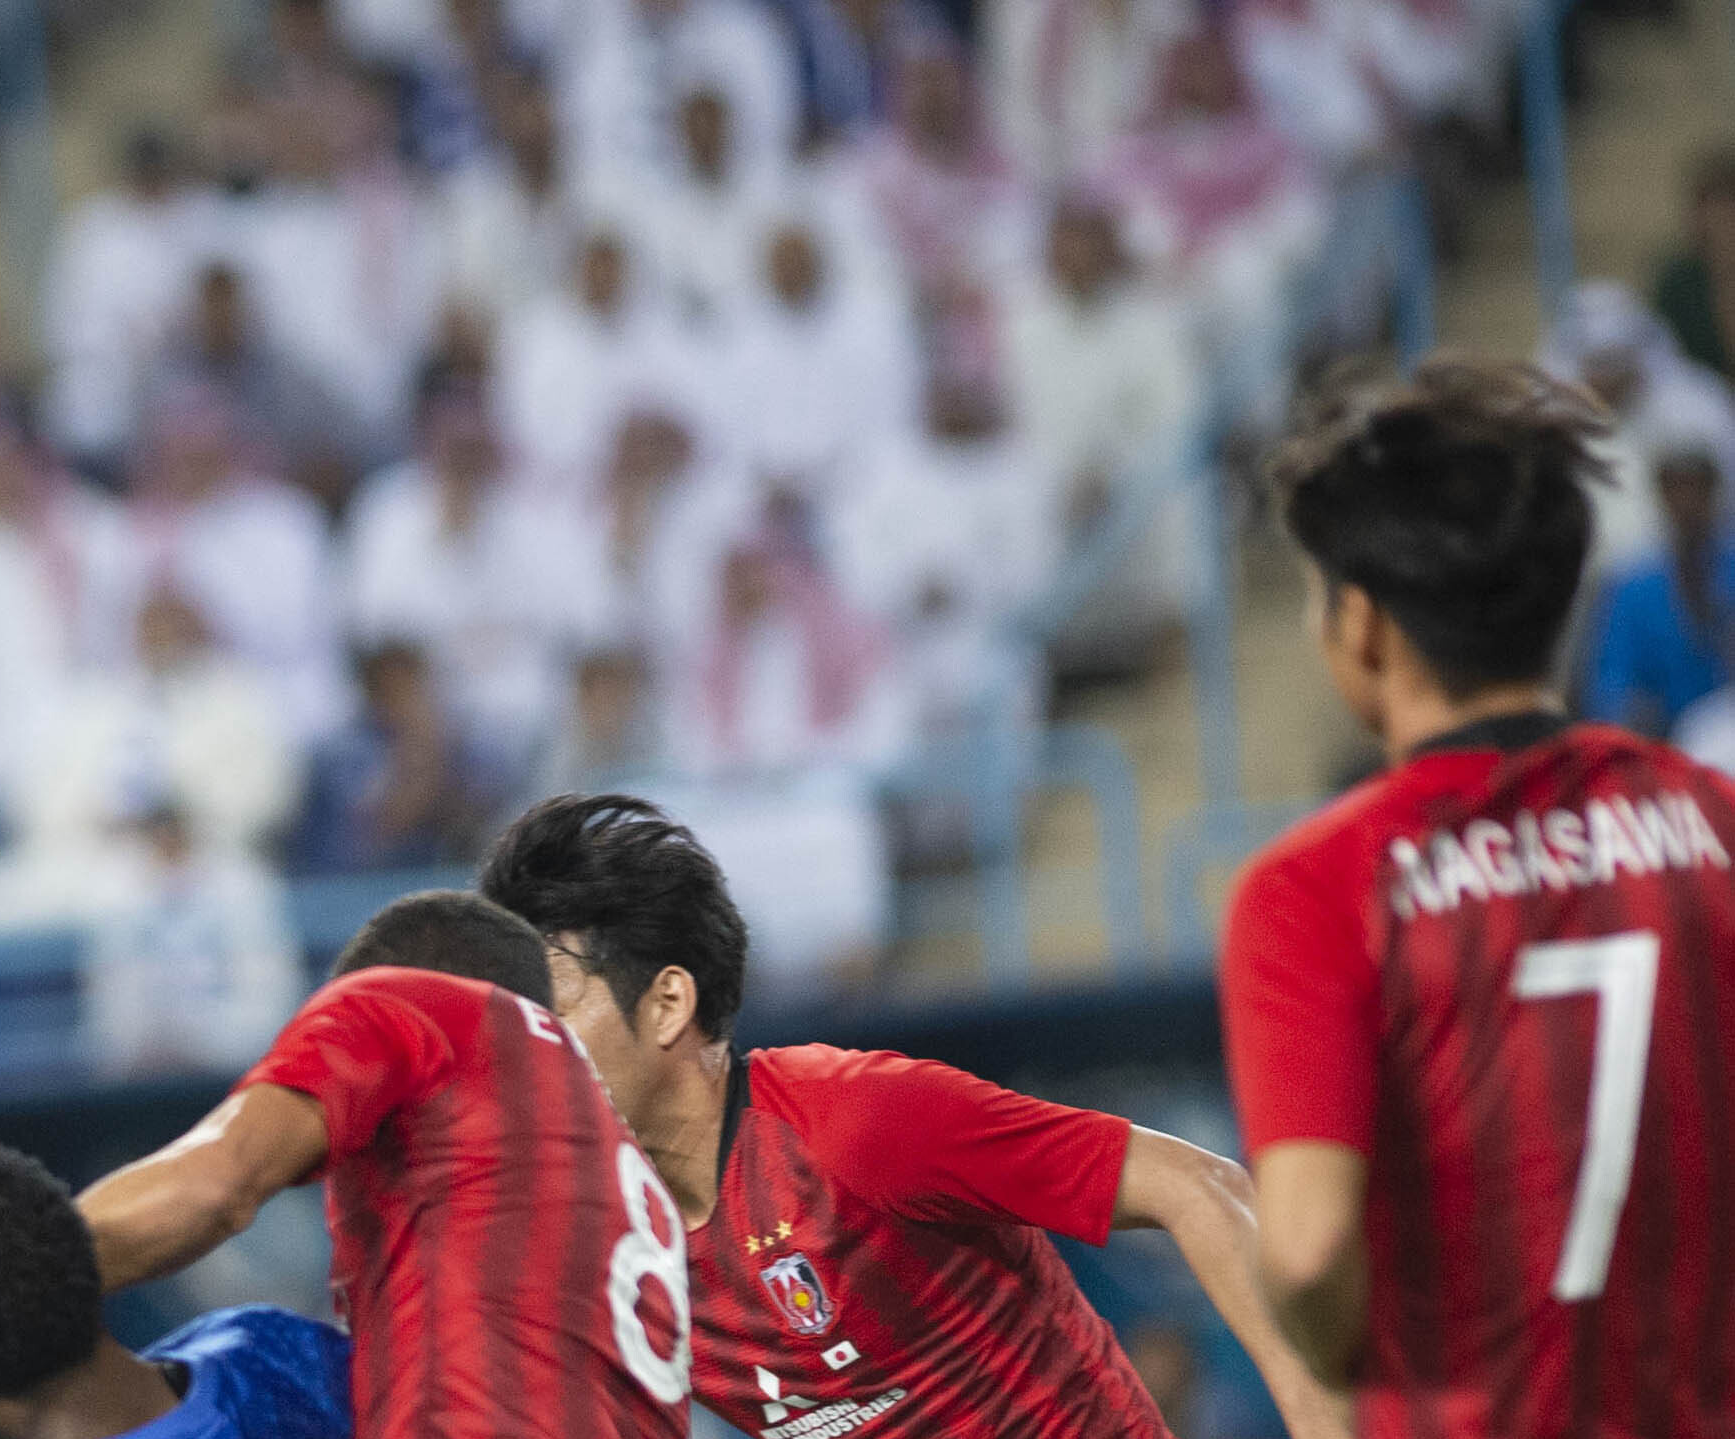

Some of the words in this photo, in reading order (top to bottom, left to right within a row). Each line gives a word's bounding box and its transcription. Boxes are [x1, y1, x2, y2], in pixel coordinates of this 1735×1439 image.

[1388, 791, 1733, 920] NAGASAWA
[1511, 930, 1660, 1304] 7
[606, 1143, 692, 1404] 8
